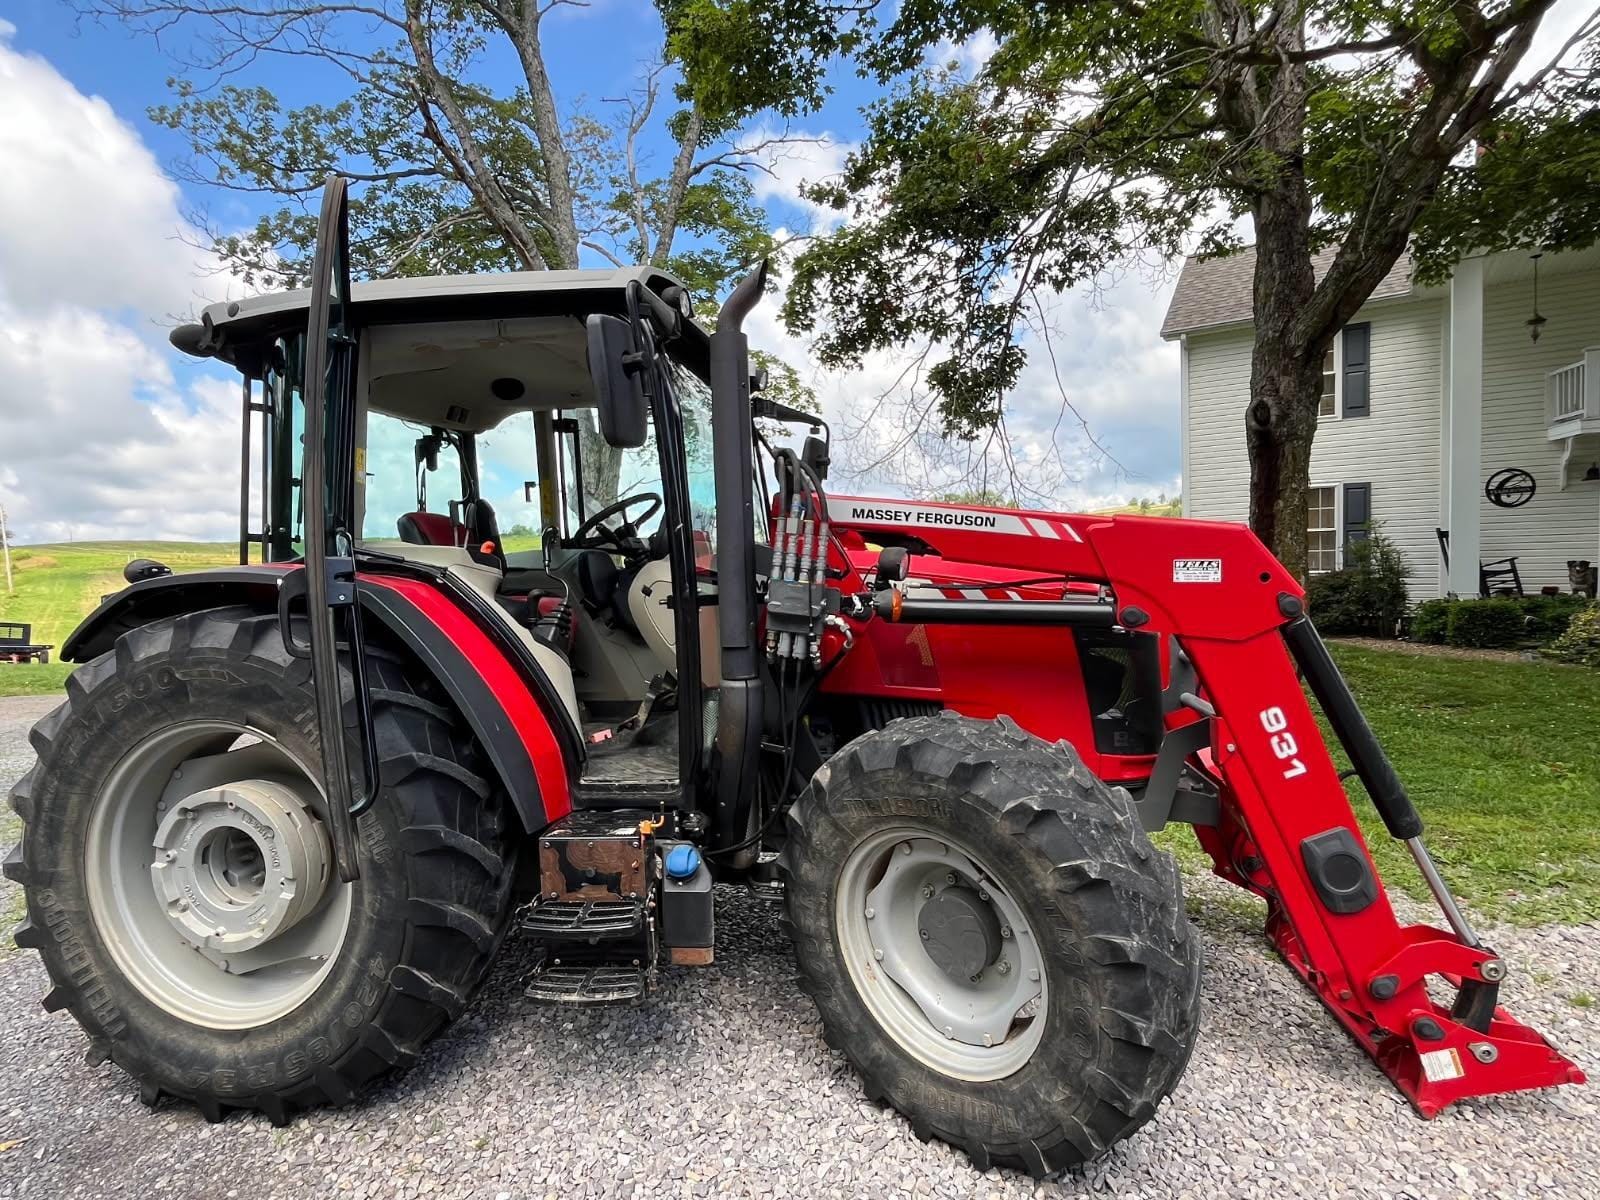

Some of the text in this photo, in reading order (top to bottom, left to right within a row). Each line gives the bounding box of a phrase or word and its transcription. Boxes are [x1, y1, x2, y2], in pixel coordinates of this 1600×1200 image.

[852, 508, 996, 528] MASSEY FERGUSON
[1259, 706, 1308, 779] 931
[36, 888, 128, 1037] TRELLEBORG
